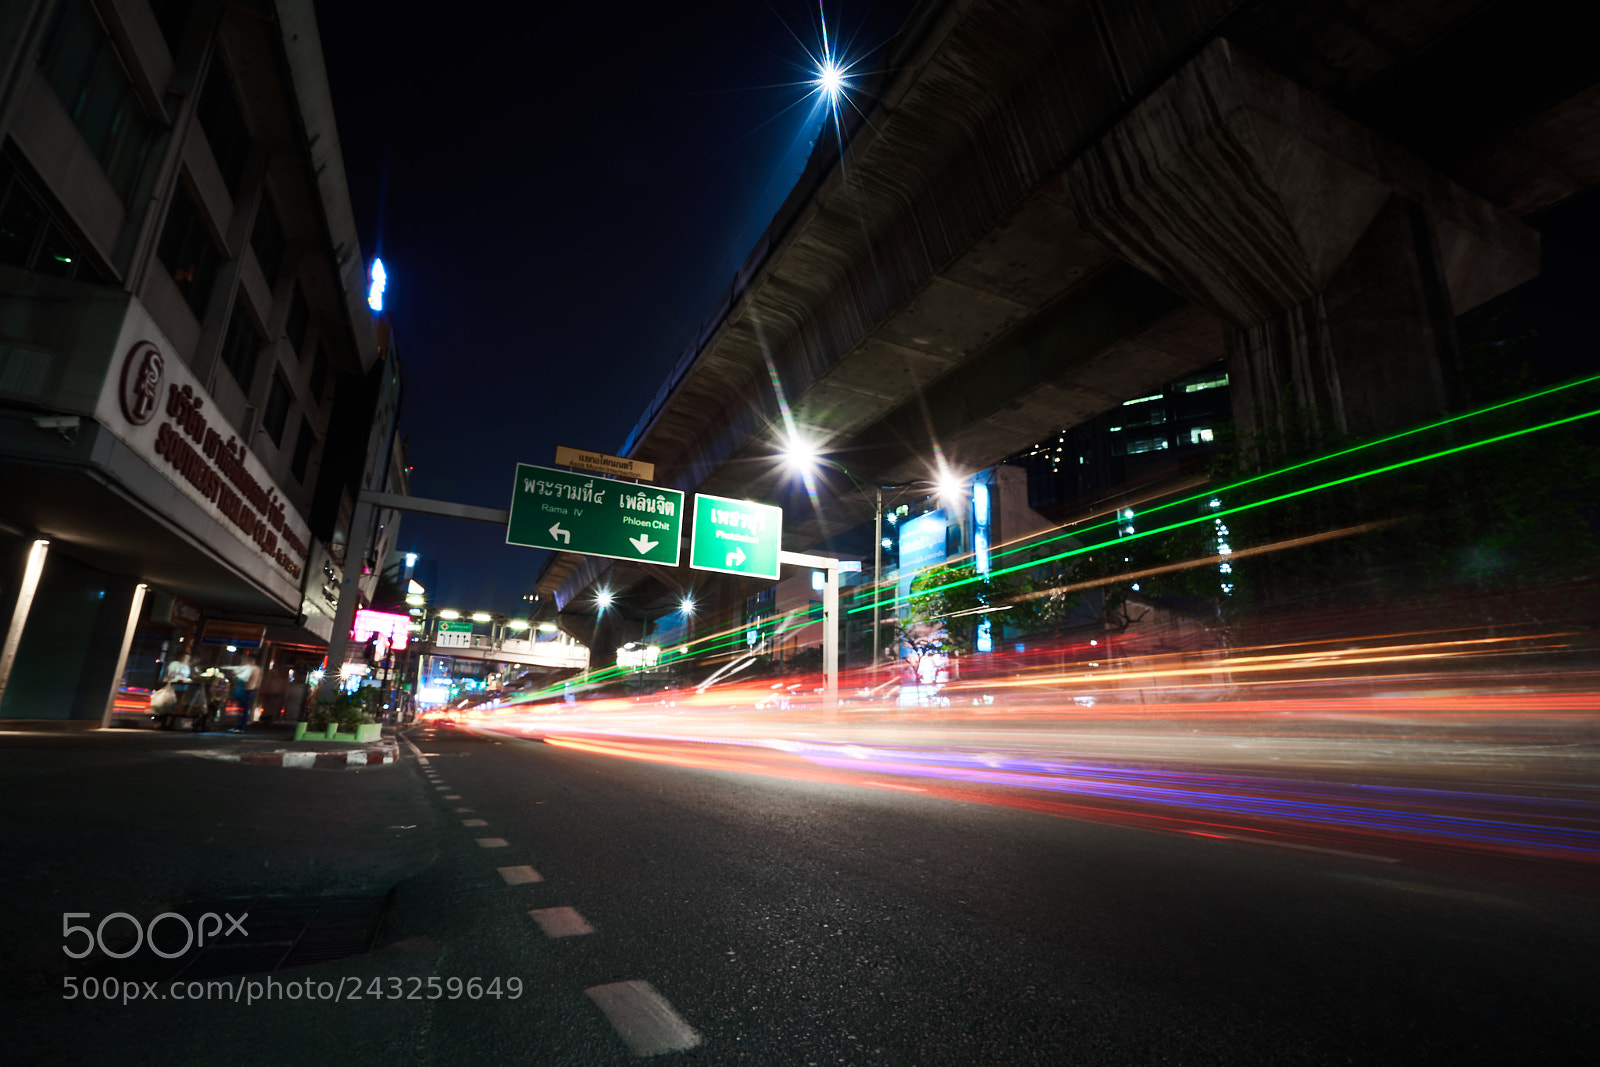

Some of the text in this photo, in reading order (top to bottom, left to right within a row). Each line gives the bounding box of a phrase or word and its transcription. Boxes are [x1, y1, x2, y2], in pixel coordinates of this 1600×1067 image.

[155, 422, 223, 503] SOUTHEAST
[541, 503, 583, 517] Rama IV
[620, 492, 674, 516] เพลินจิต
[623, 516, 670, 531] Phloen Chit
